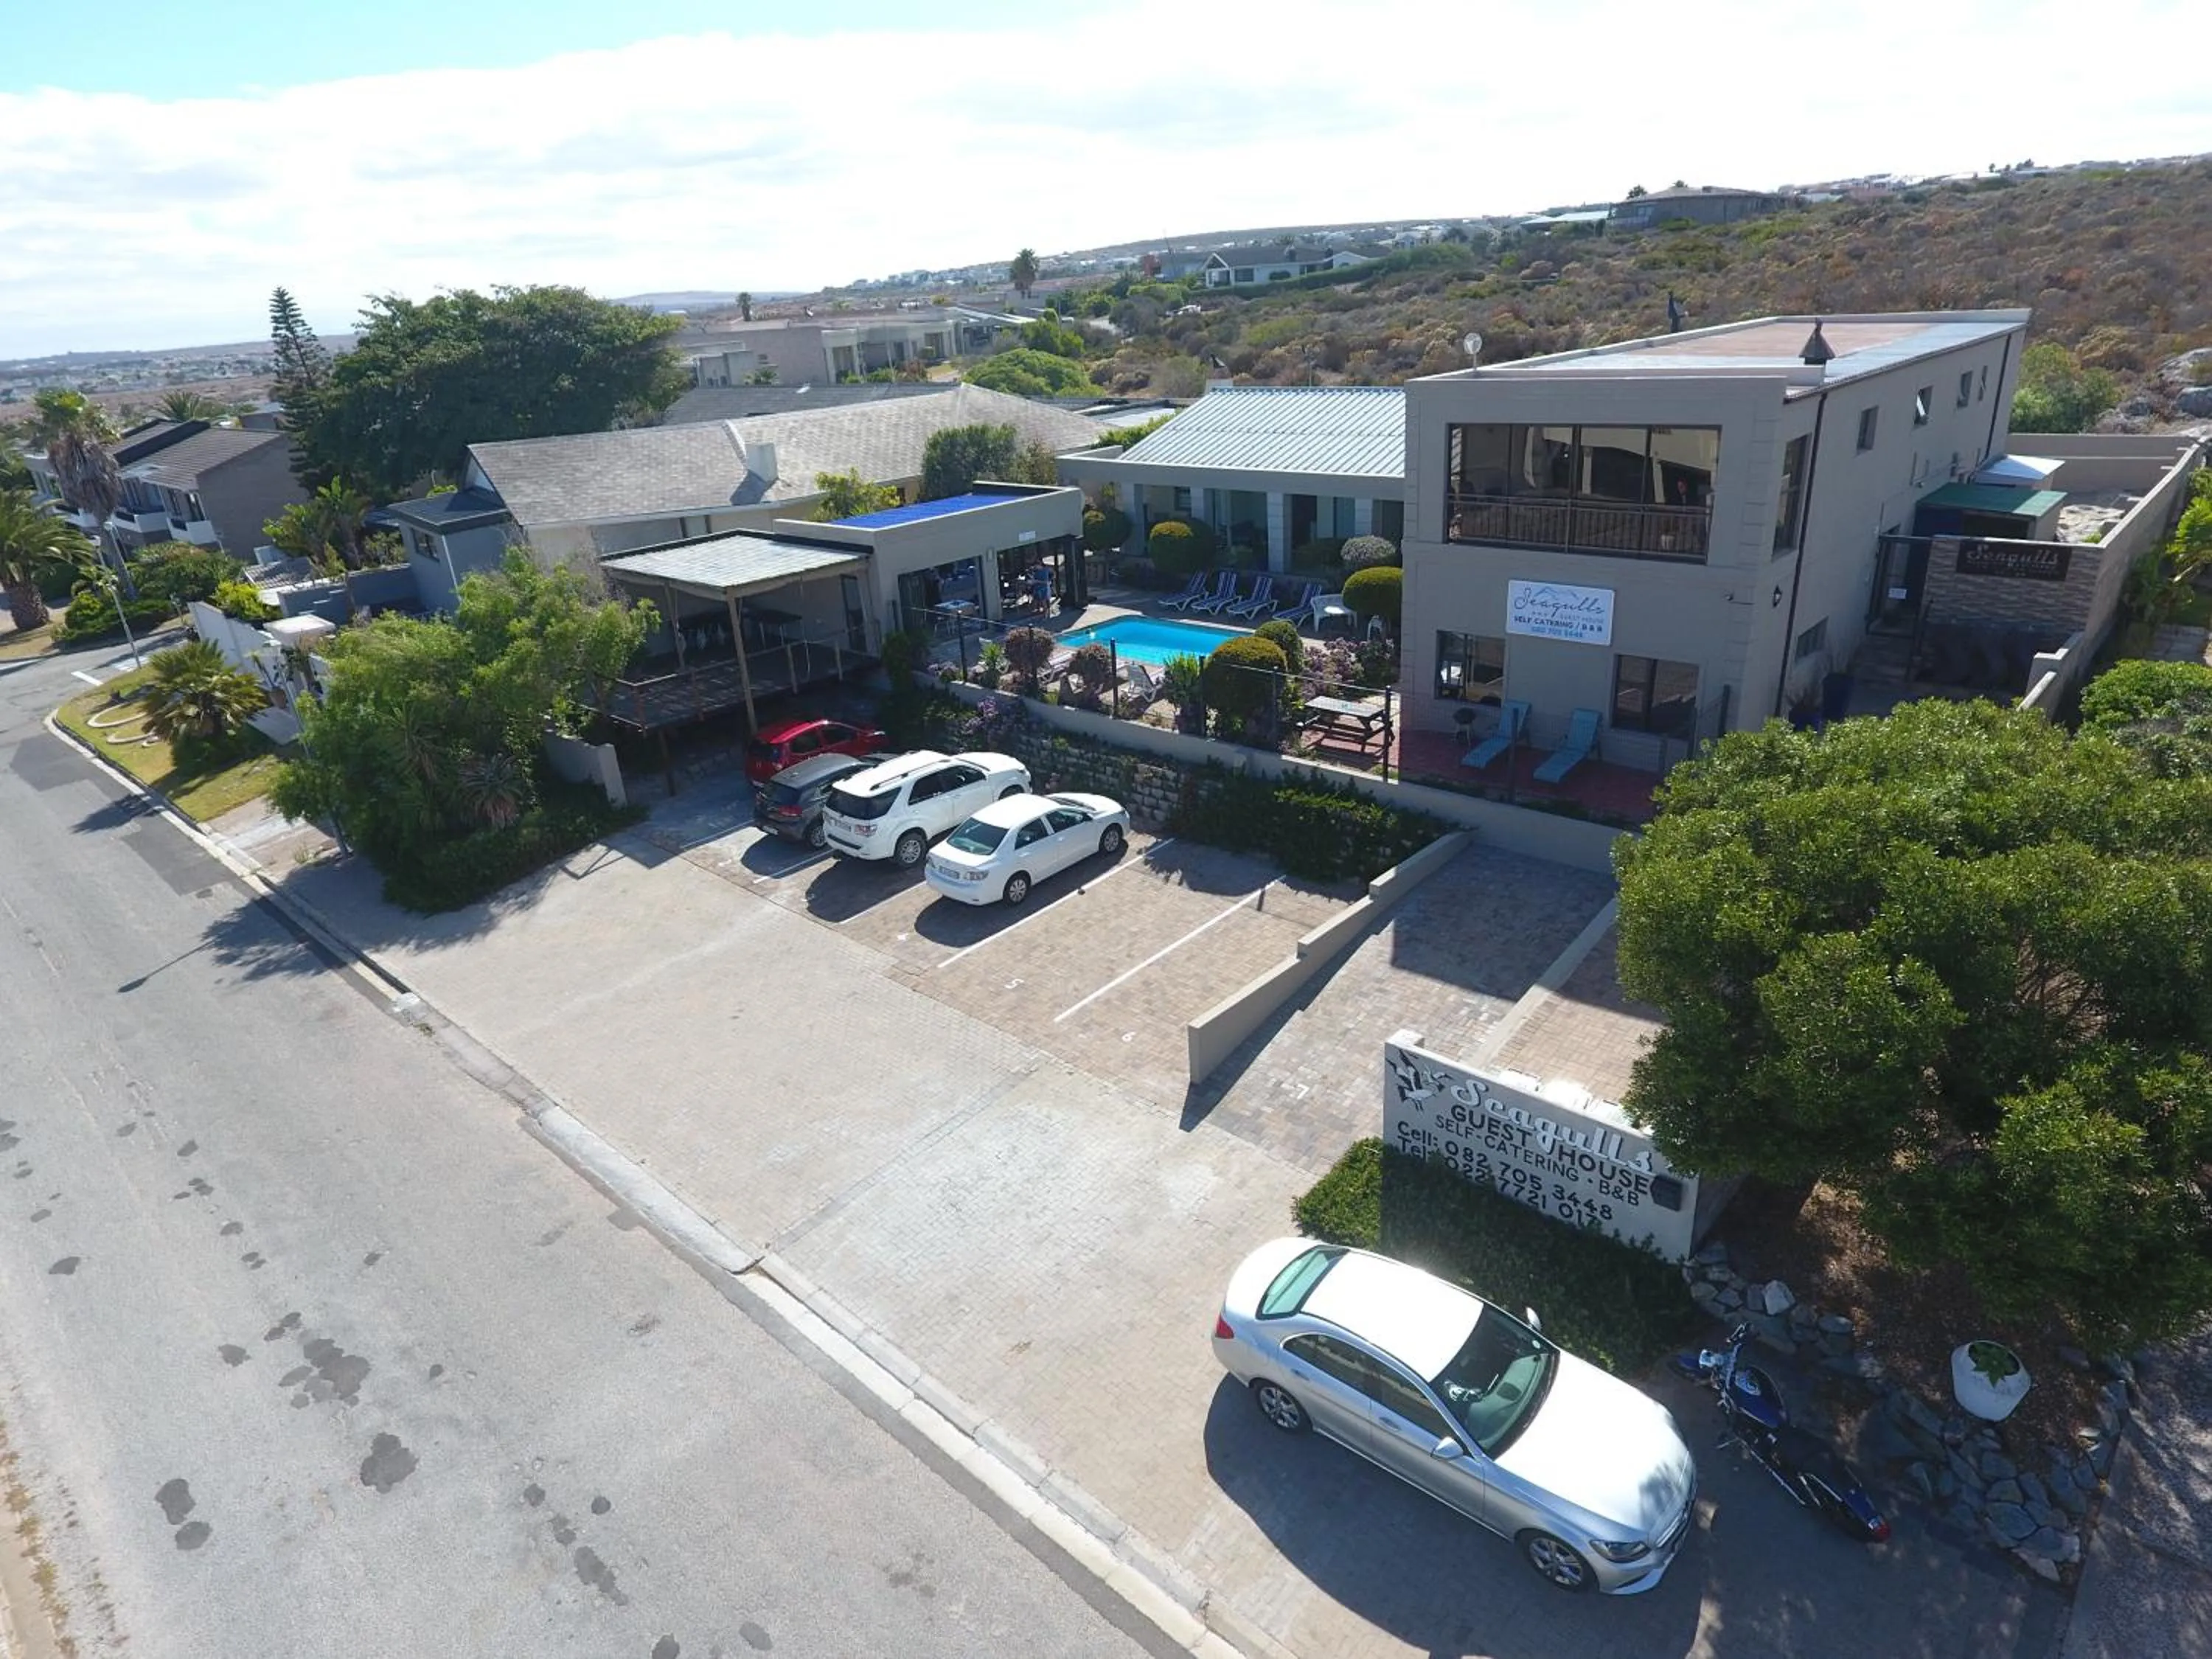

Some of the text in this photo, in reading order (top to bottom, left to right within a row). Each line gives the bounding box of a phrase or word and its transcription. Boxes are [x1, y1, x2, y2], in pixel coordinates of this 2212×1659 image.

[1514, 587, 1605, 617] Seagulls
[1514, 616, 1532, 624] SELF
[1534, 617, 1574, 629] CATERING
[1121, 1032, 1136, 1042] 6
[1435, 1114, 1639, 1206] SELF-CATERING B&B
[1450, 1079, 1657, 1175] Seagulls
[1451, 1105, 1649, 1195] GUEST HOUSE
[1397, 1121, 1613, 1220] Cell: 082 705 3448
[1445, 1156, 1487, 1183] 022
[1498, 1177, 1546, 1209] 7721
